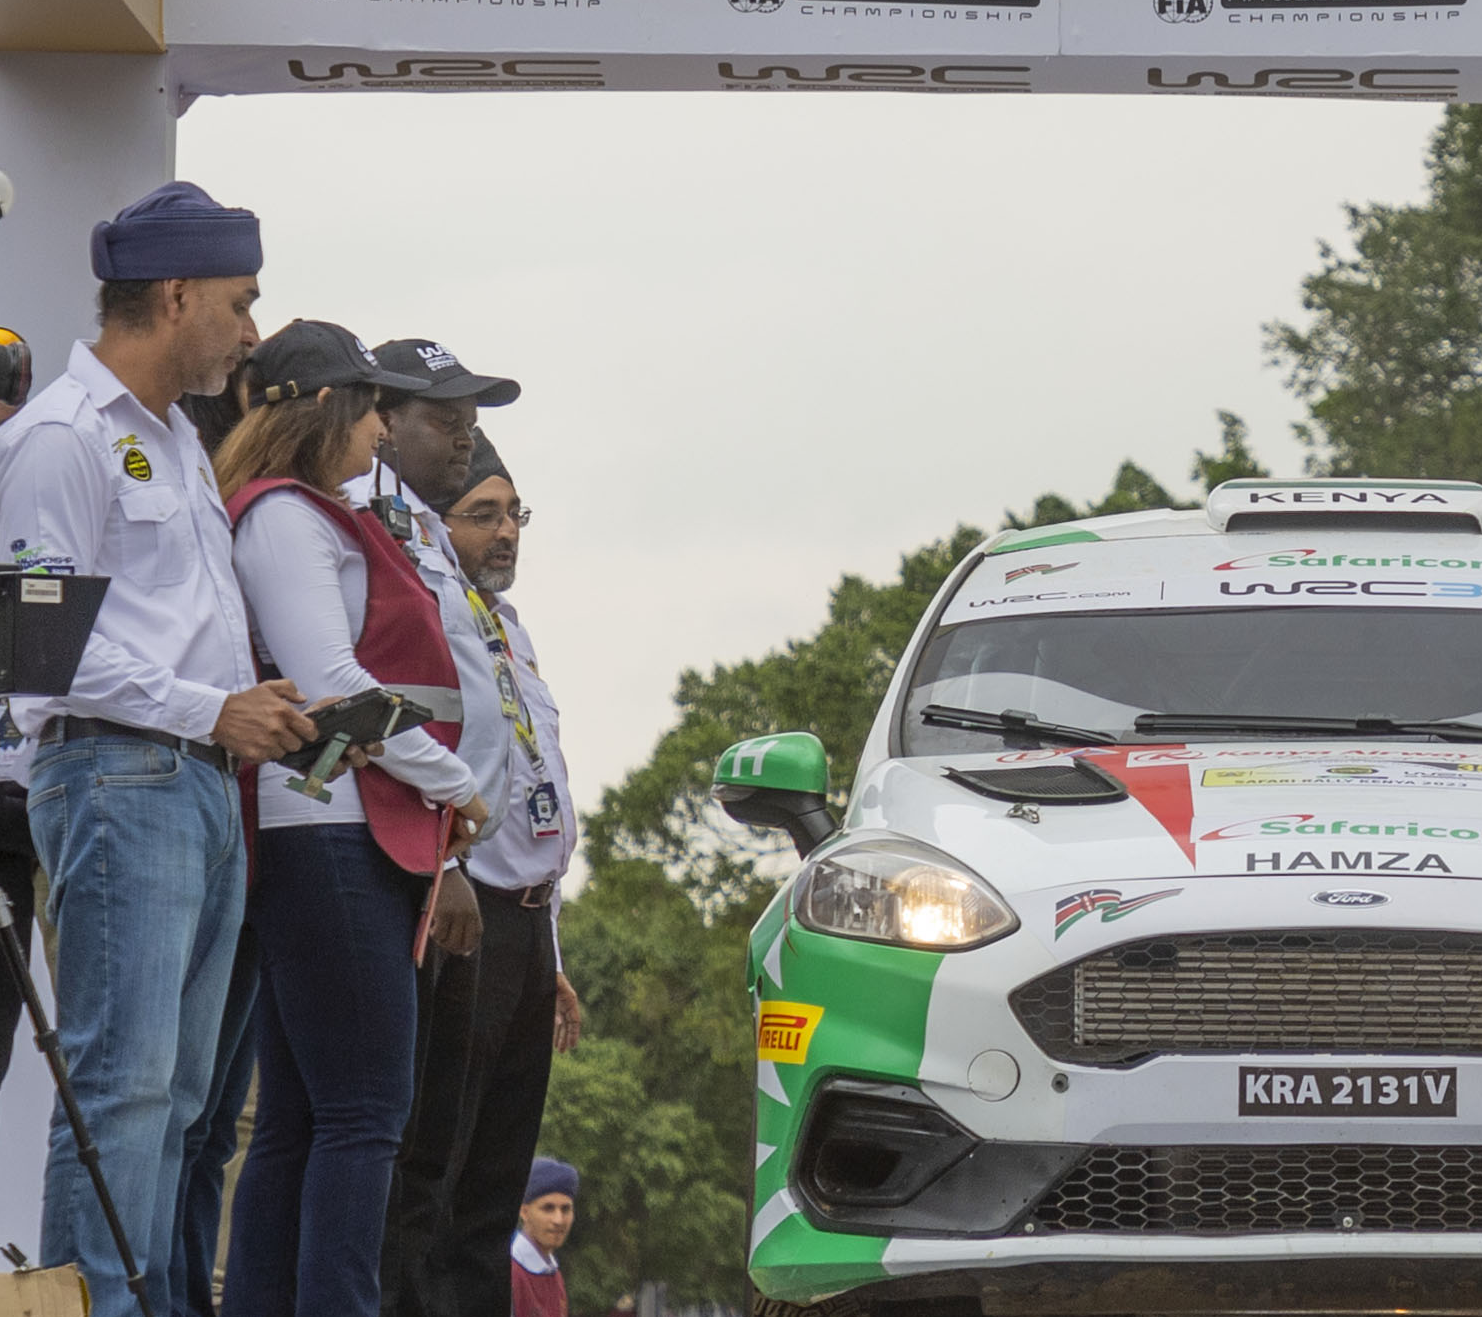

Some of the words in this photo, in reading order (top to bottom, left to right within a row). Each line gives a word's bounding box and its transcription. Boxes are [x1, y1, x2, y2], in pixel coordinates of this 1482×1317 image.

[800, 5, 1034, 22] CHAMPIONSHIP
[1228, 10, 1461, 24] CHAMPIONSHIP
[1248, 490, 1449, 505] KENYA
[1216, 749, 1314, 760] Kenya
[1245, 851, 1454, 873] HAMZA
[1329, 891, 1374, 905] Ford
[1245, 1074, 1322, 1105] KRA
[1331, 1074, 1452, 1105] 2131V
